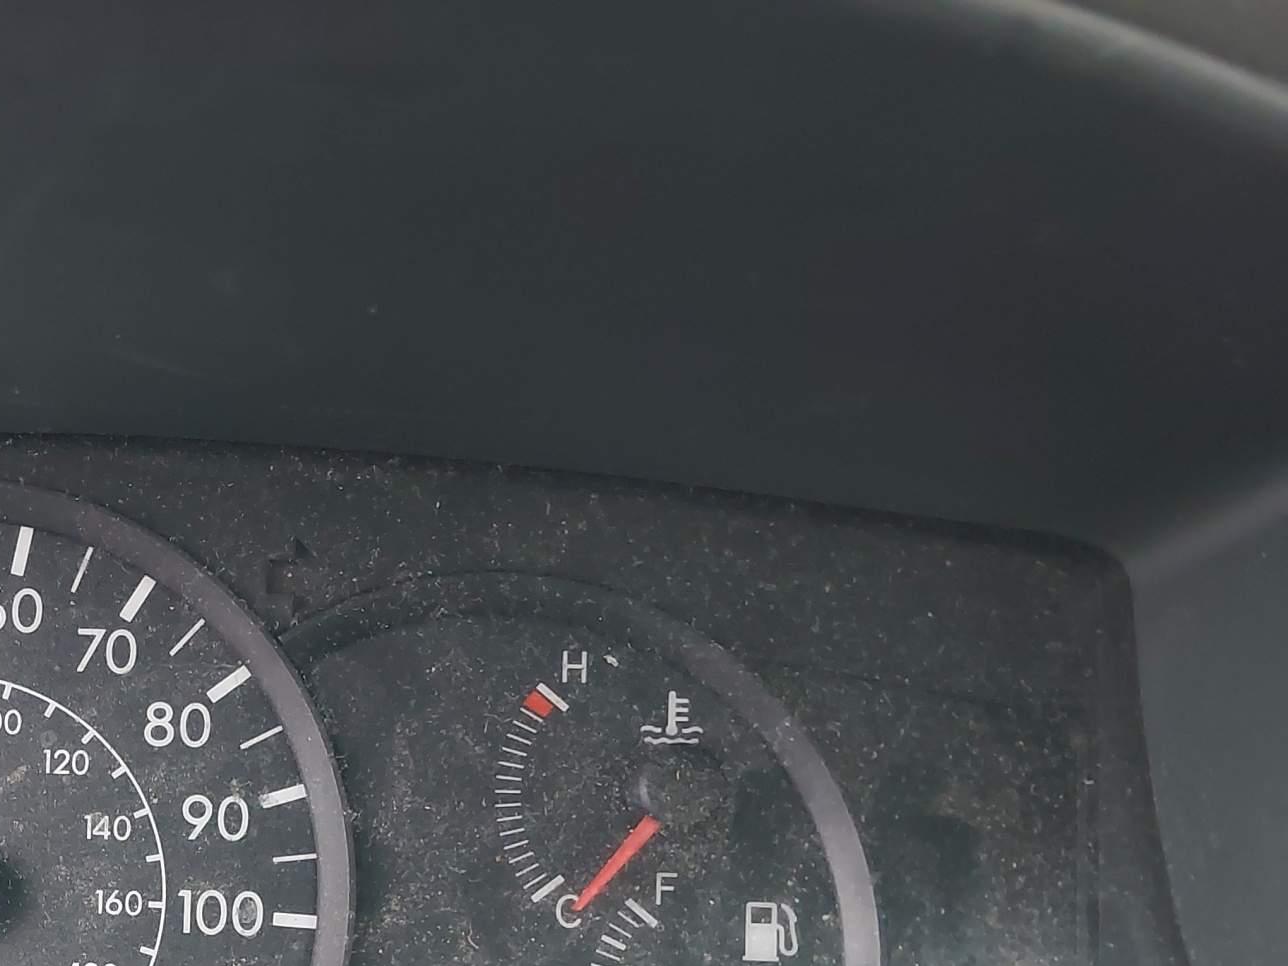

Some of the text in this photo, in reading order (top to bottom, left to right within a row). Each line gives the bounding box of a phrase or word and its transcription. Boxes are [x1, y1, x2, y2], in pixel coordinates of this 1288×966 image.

[76, 628, 138, 675] 70
[562, 652, 587, 683] H
[144, 702, 211, 747] 80
[44, 750, 89, 776] 120
[85, 816, 131, 841] 140
[181, 796, 249, 841] 90
[95, 891, 142, 916] 160
[655, 873, 678, 906] F
[179, 890, 264, 935] 100
[556, 894, 582, 928] C
